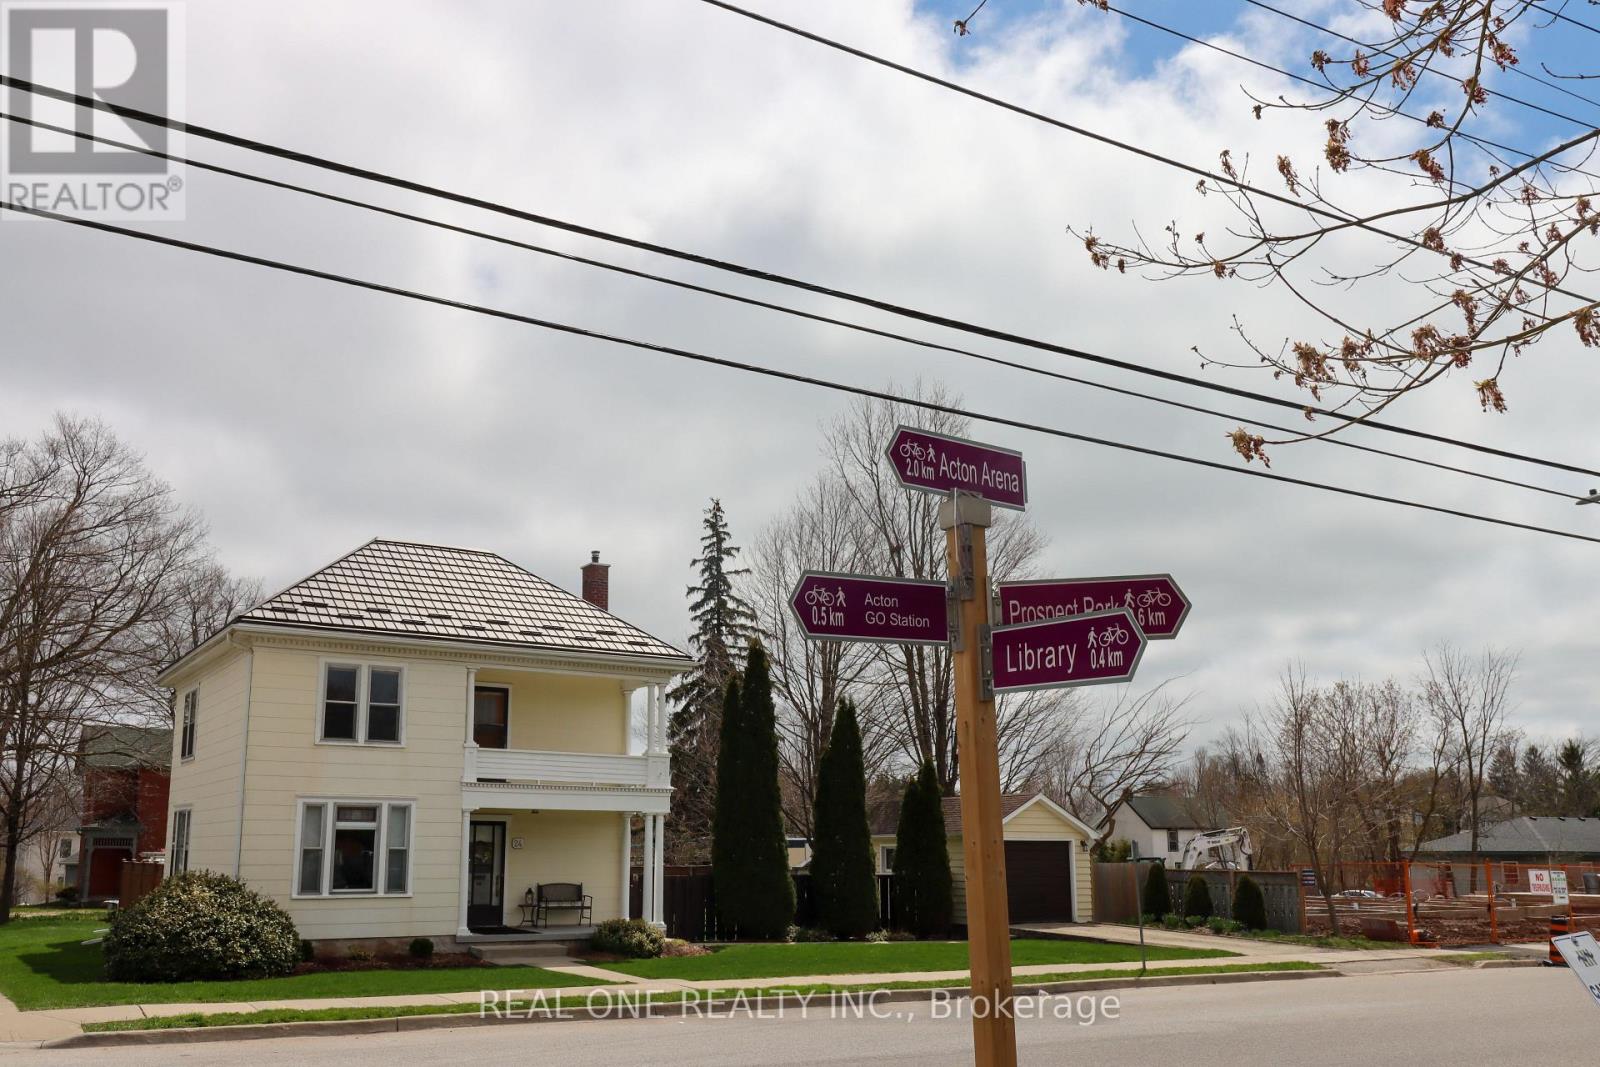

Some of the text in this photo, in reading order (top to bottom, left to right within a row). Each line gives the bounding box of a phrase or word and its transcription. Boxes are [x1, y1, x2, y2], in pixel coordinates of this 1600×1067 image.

[906, 458, 935, 481] 2.0 km
[939, 452, 1020, 493] Acton Arena
[864, 592, 899, 608] Acton
[812, 605, 845, 627] 0.5 km
[865, 610, 930, 628] GO Station
[1147, 607, 1166, 627] km
[1006, 642, 1077, 674] Library
[1090, 648, 1124, 670] 0.4 km
[1535, 873, 1545, 882] NO
